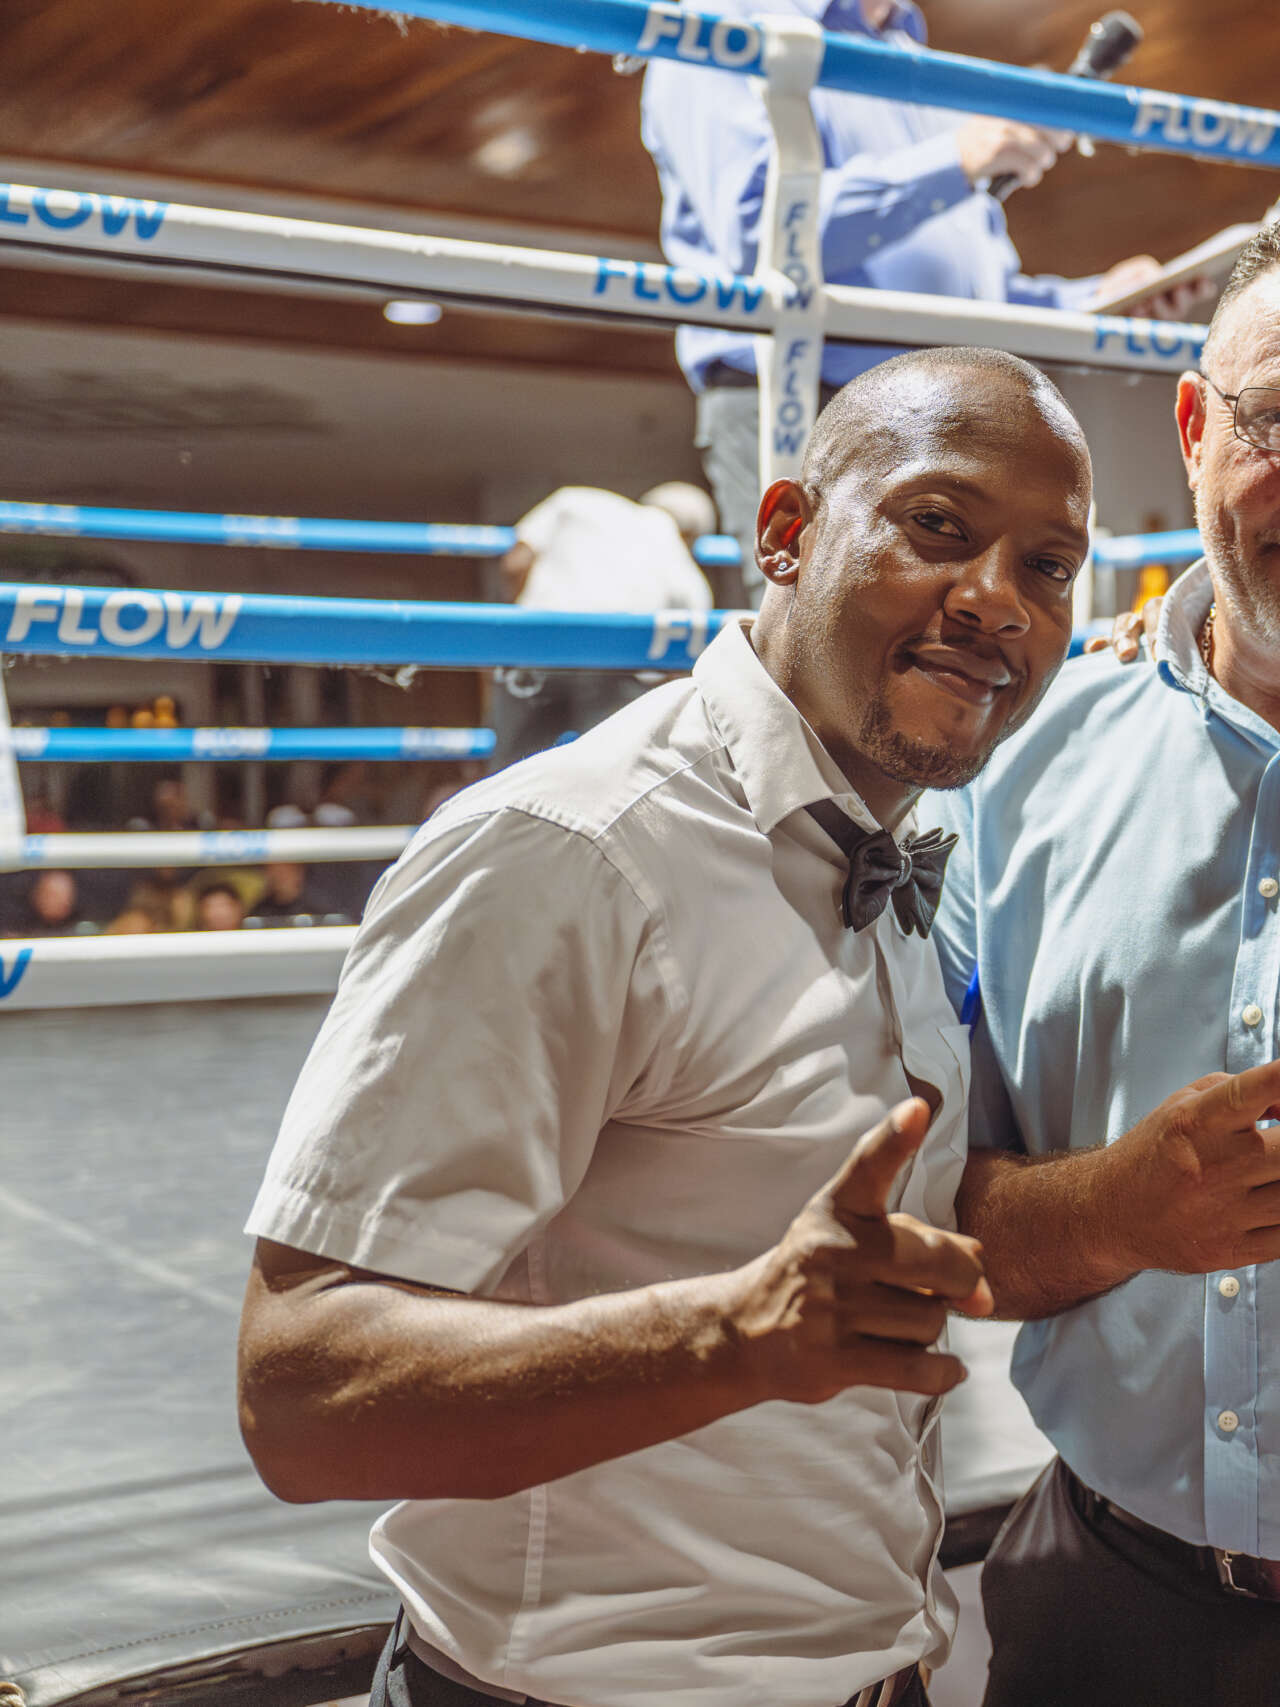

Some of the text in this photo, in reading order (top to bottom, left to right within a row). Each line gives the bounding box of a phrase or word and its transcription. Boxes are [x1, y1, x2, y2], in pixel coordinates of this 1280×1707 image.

[638, 5, 769, 67] FLO
[1131, 91, 1276, 154] FLOW
[0, 184, 168, 239] LOW
[594, 257, 765, 314] FLOW
[782, 202, 814, 310] FLOW
[774, 339, 807, 454] FLOW
[6, 586, 243, 649] FLOW
[648, 609, 709, 660] FL
